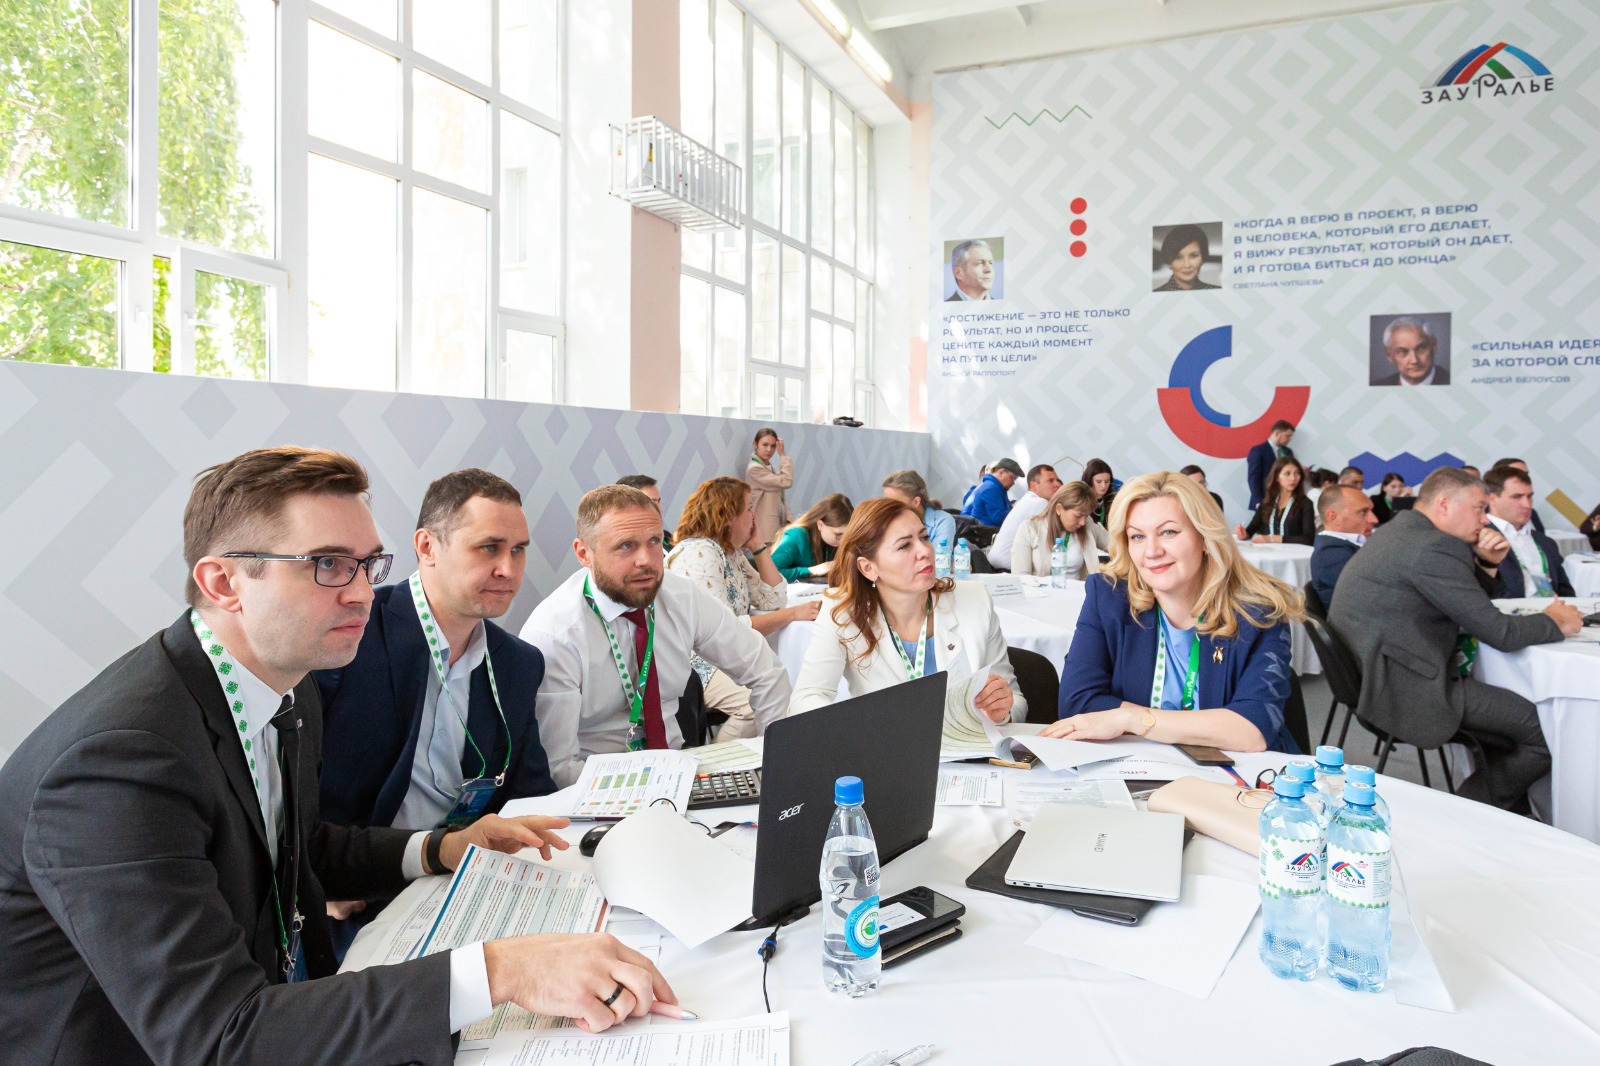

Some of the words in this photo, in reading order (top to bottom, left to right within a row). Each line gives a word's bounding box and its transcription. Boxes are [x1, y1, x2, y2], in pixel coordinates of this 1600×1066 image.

[1421, 73, 1554, 104] ЗАУРАЛЬЕ
[1234, 218, 1283, 229] «КОГДА
[1287, 217, 1296, 225] Я
[1300, 213, 1340, 225] ВЕРЮ
[1344, 212, 1353, 221] В
[1358, 208, 1416, 220] ПРОЕКТ,
[1421, 207, 1430, 216] Я
[1435, 203, 1478, 215] ВЕРЮ
[1234, 235, 1242, 244] В
[1246, 230, 1321, 243] ЧЕЛОВЕКА,
[1325, 224, 1394, 238] КОТОРЫЙ
[1399, 223, 1426, 234] ЕГО
[1429, 219, 1491, 233] ДЕЛАЕТ,
[1234, 250, 1242, 259] Я
[1246, 248, 1285, 258] ВИЖУ
[1289, 242, 1366, 255] РЕЗУЛЬТАТ,
[1370, 236, 1441, 251] КОТОРЫЙ
[1445, 237, 1466, 247] ОН
[1470, 234, 1513, 246] ДАЕТ,
[1233, 265, 1242, 274] И
[1247, 264, 1255, 273] Я
[1259, 262, 1311, 273] ГОТОВА
[1315, 258, 1369, 270] БИТЬСЯ
[1373, 256, 1394, 267] ДО
[1398, 254, 1456, 265] КОНЦА»
[1232, 281, 1279, 290] СВЕТЛАНА
[1040, 311, 1061, 320] ЭТО
[1065, 310, 1080, 319] НЕ
[1084, 308, 1131, 318] ТОЛЬКО
[943, 327, 1002, 336] РУЛЬТАТ,
[1006, 326, 1022, 335] НО
[1025, 326, 1033, 334] И
[942, 341, 985, 350] ЦЕНИТЕ
[988, 338, 1040, 349] КАЖДЫЙ
[1043, 338, 1094, 348] МОМЕНТ
[1472, 340, 1554, 351] «СИЛЬНАЯ
[942, 355, 957, 363] НА
[960, 355, 988, 363] ПУТИ
[1001, 354, 1038, 363] ЦЕЛИ»
[1472, 358, 1491, 368] ЗА
[1495, 355, 1568, 367] КОТОРОЙ
[778, 802, 805, 821] acer
